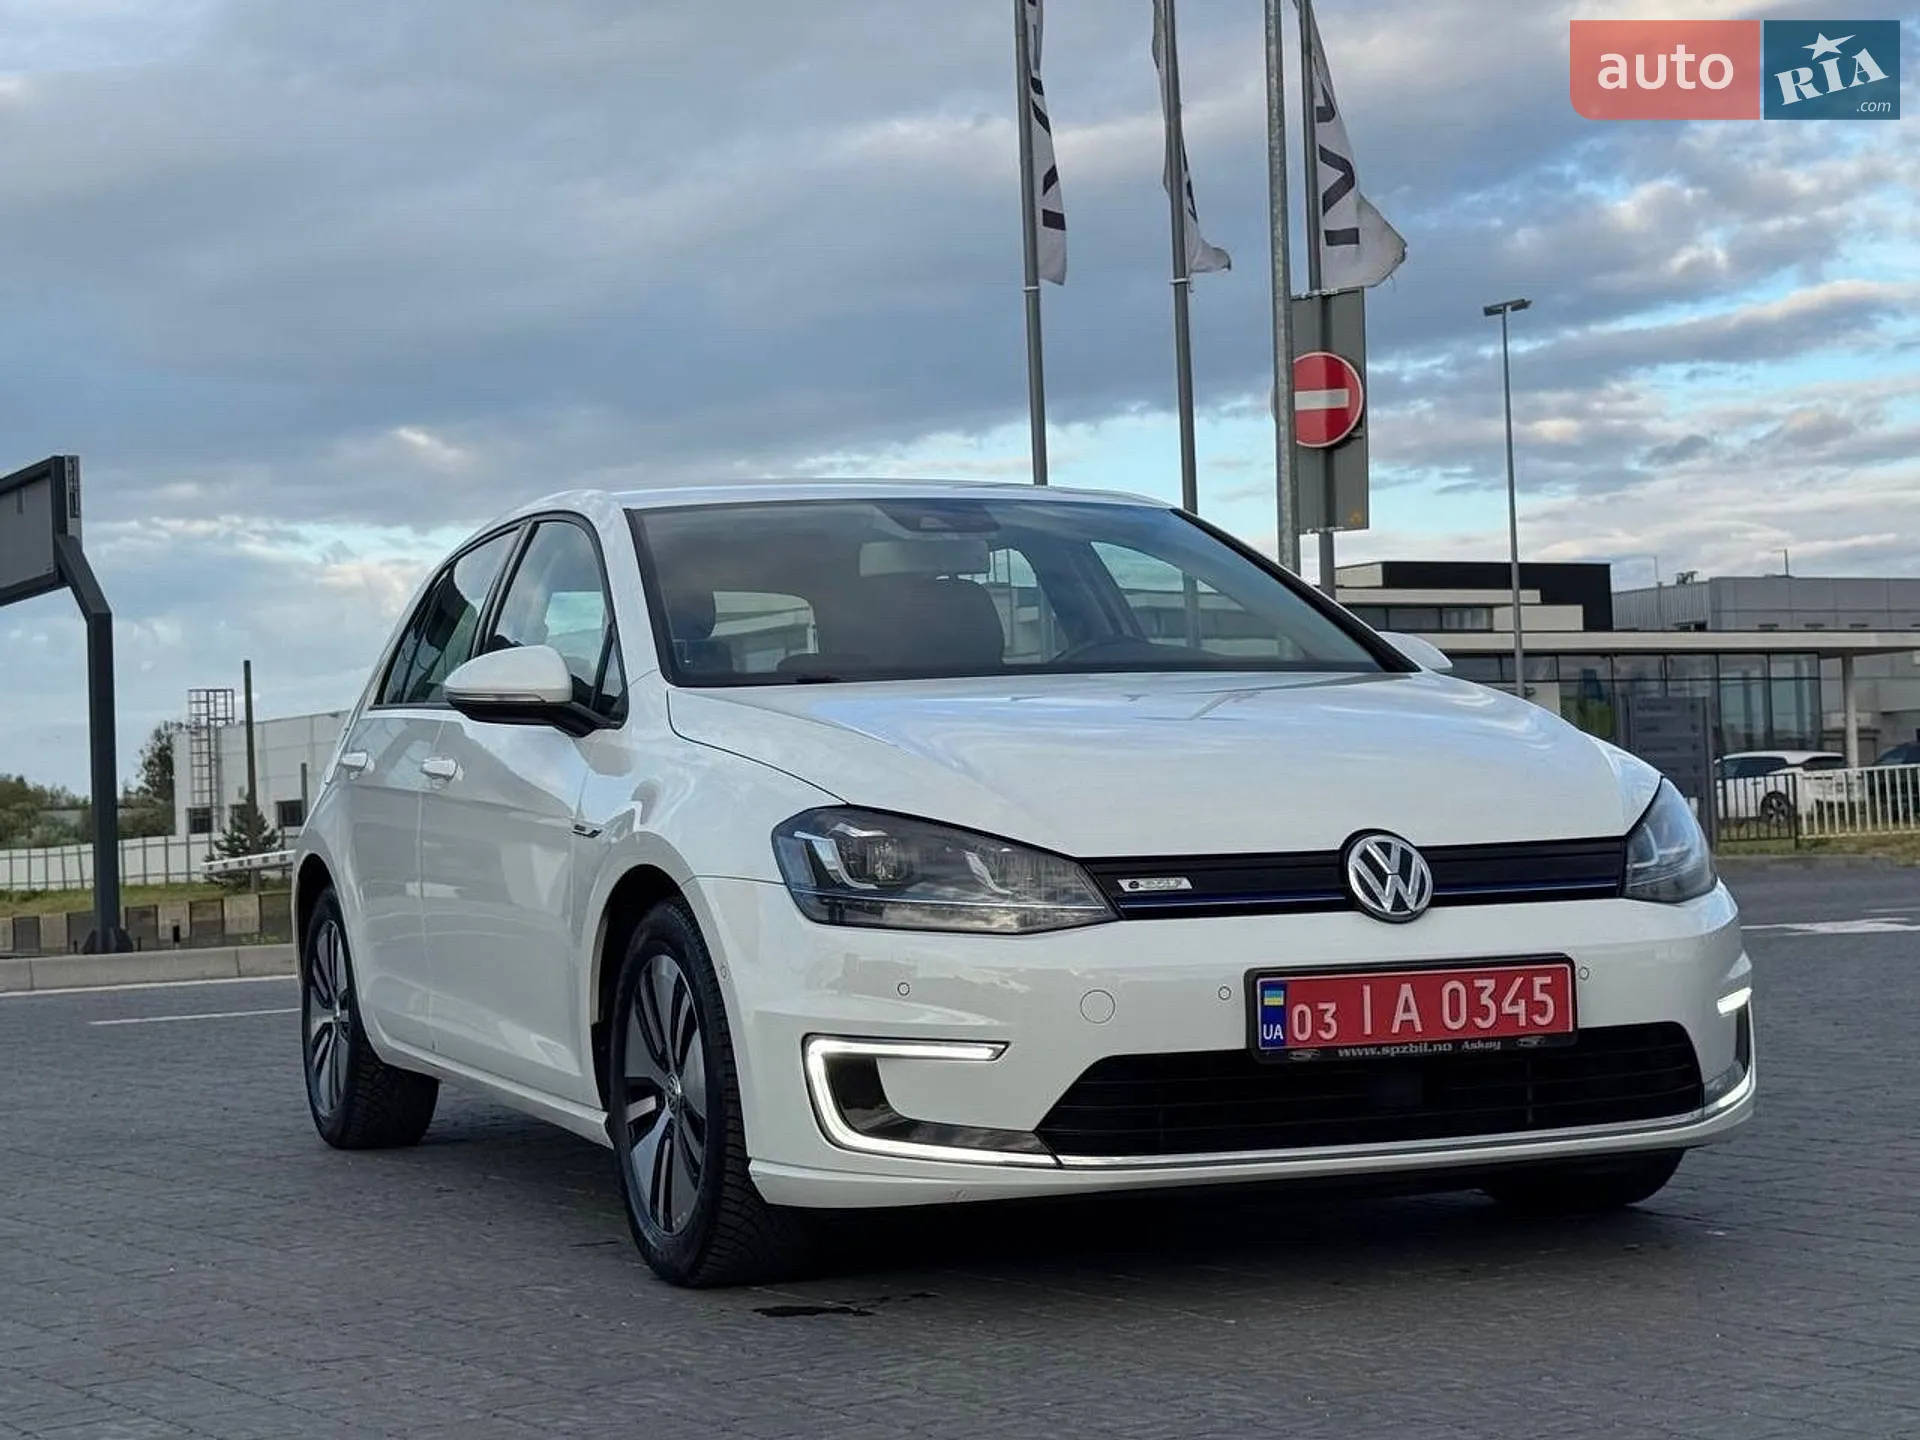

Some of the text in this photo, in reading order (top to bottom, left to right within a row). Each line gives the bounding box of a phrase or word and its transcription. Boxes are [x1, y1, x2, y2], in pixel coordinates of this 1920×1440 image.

[1291, 1002, 1338, 1041] 03
[1441, 976, 1555, 1031] 0345
[1263, 1026, 1284, 1041] UA
